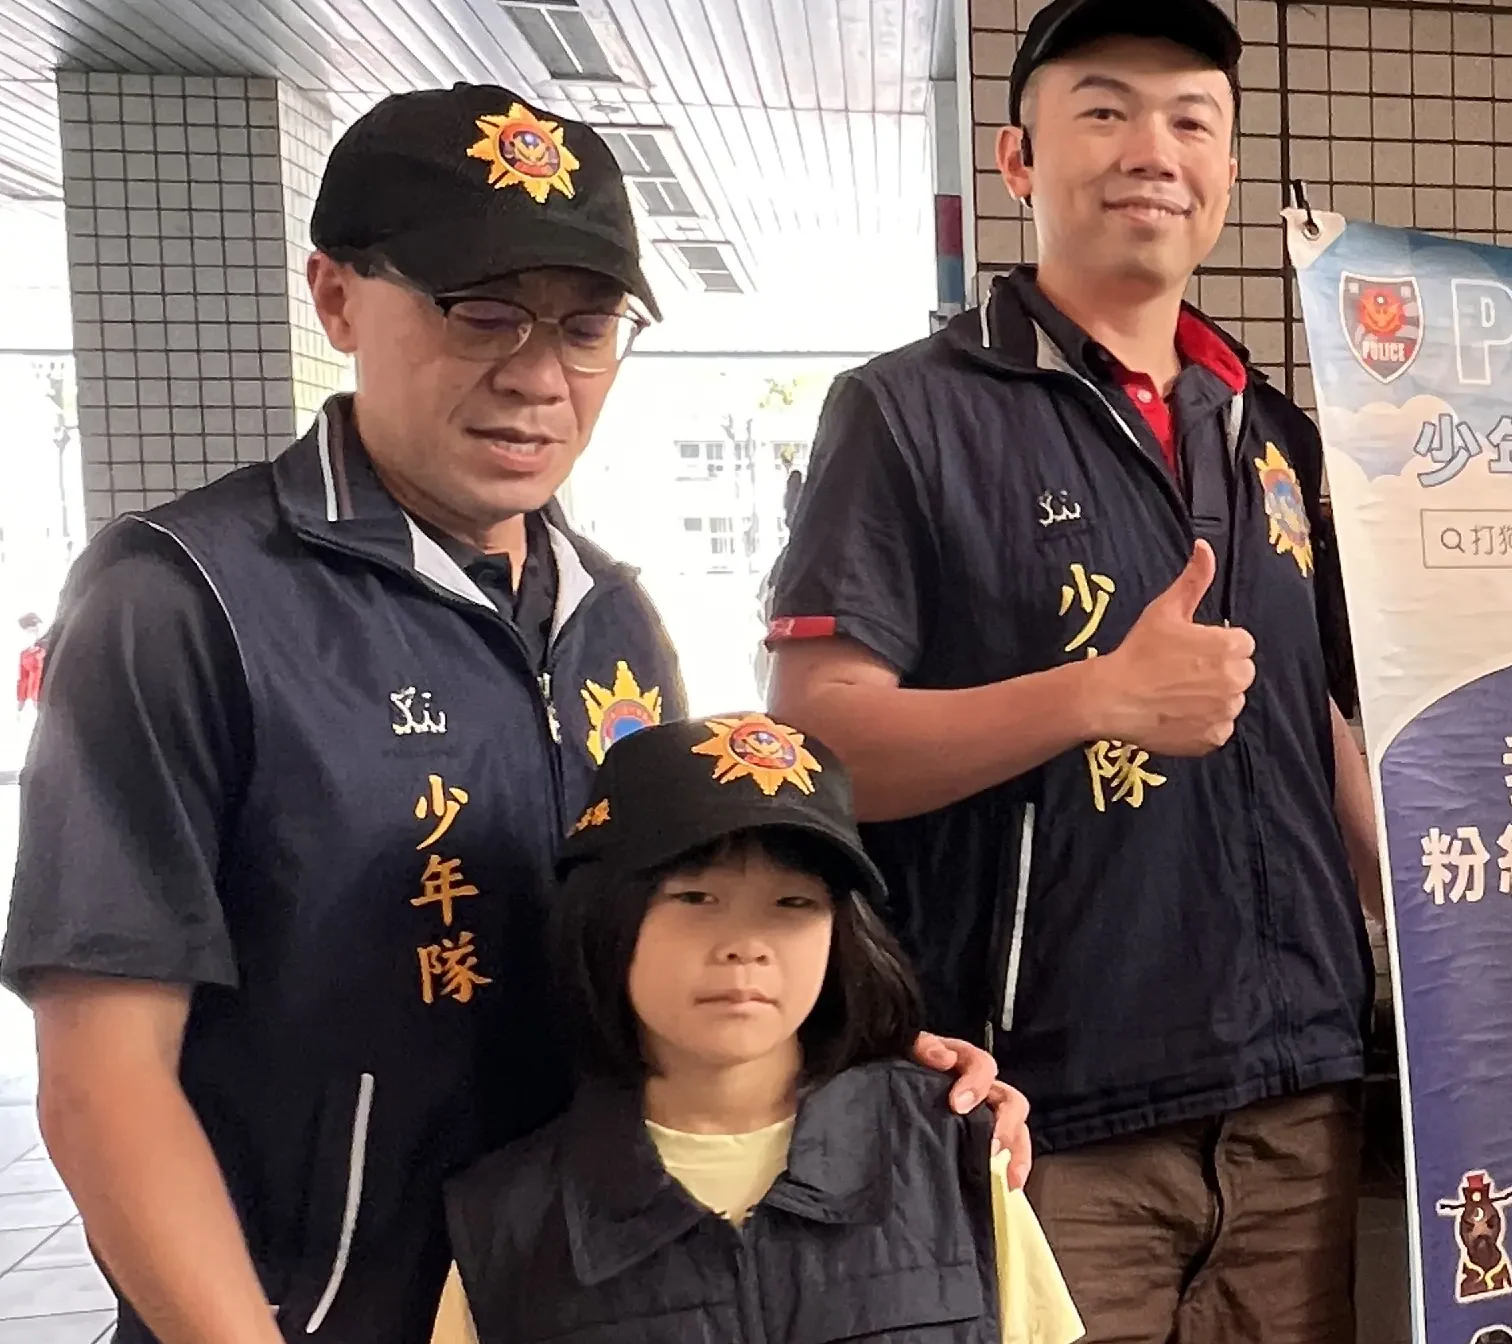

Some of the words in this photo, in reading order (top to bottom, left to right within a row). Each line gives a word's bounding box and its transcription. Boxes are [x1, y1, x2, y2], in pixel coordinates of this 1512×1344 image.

[1362, 340, 1406, 362] POLICE
[1058, 563, 1168, 812] 少隊
[410, 772, 494, 1005] 少年隊
